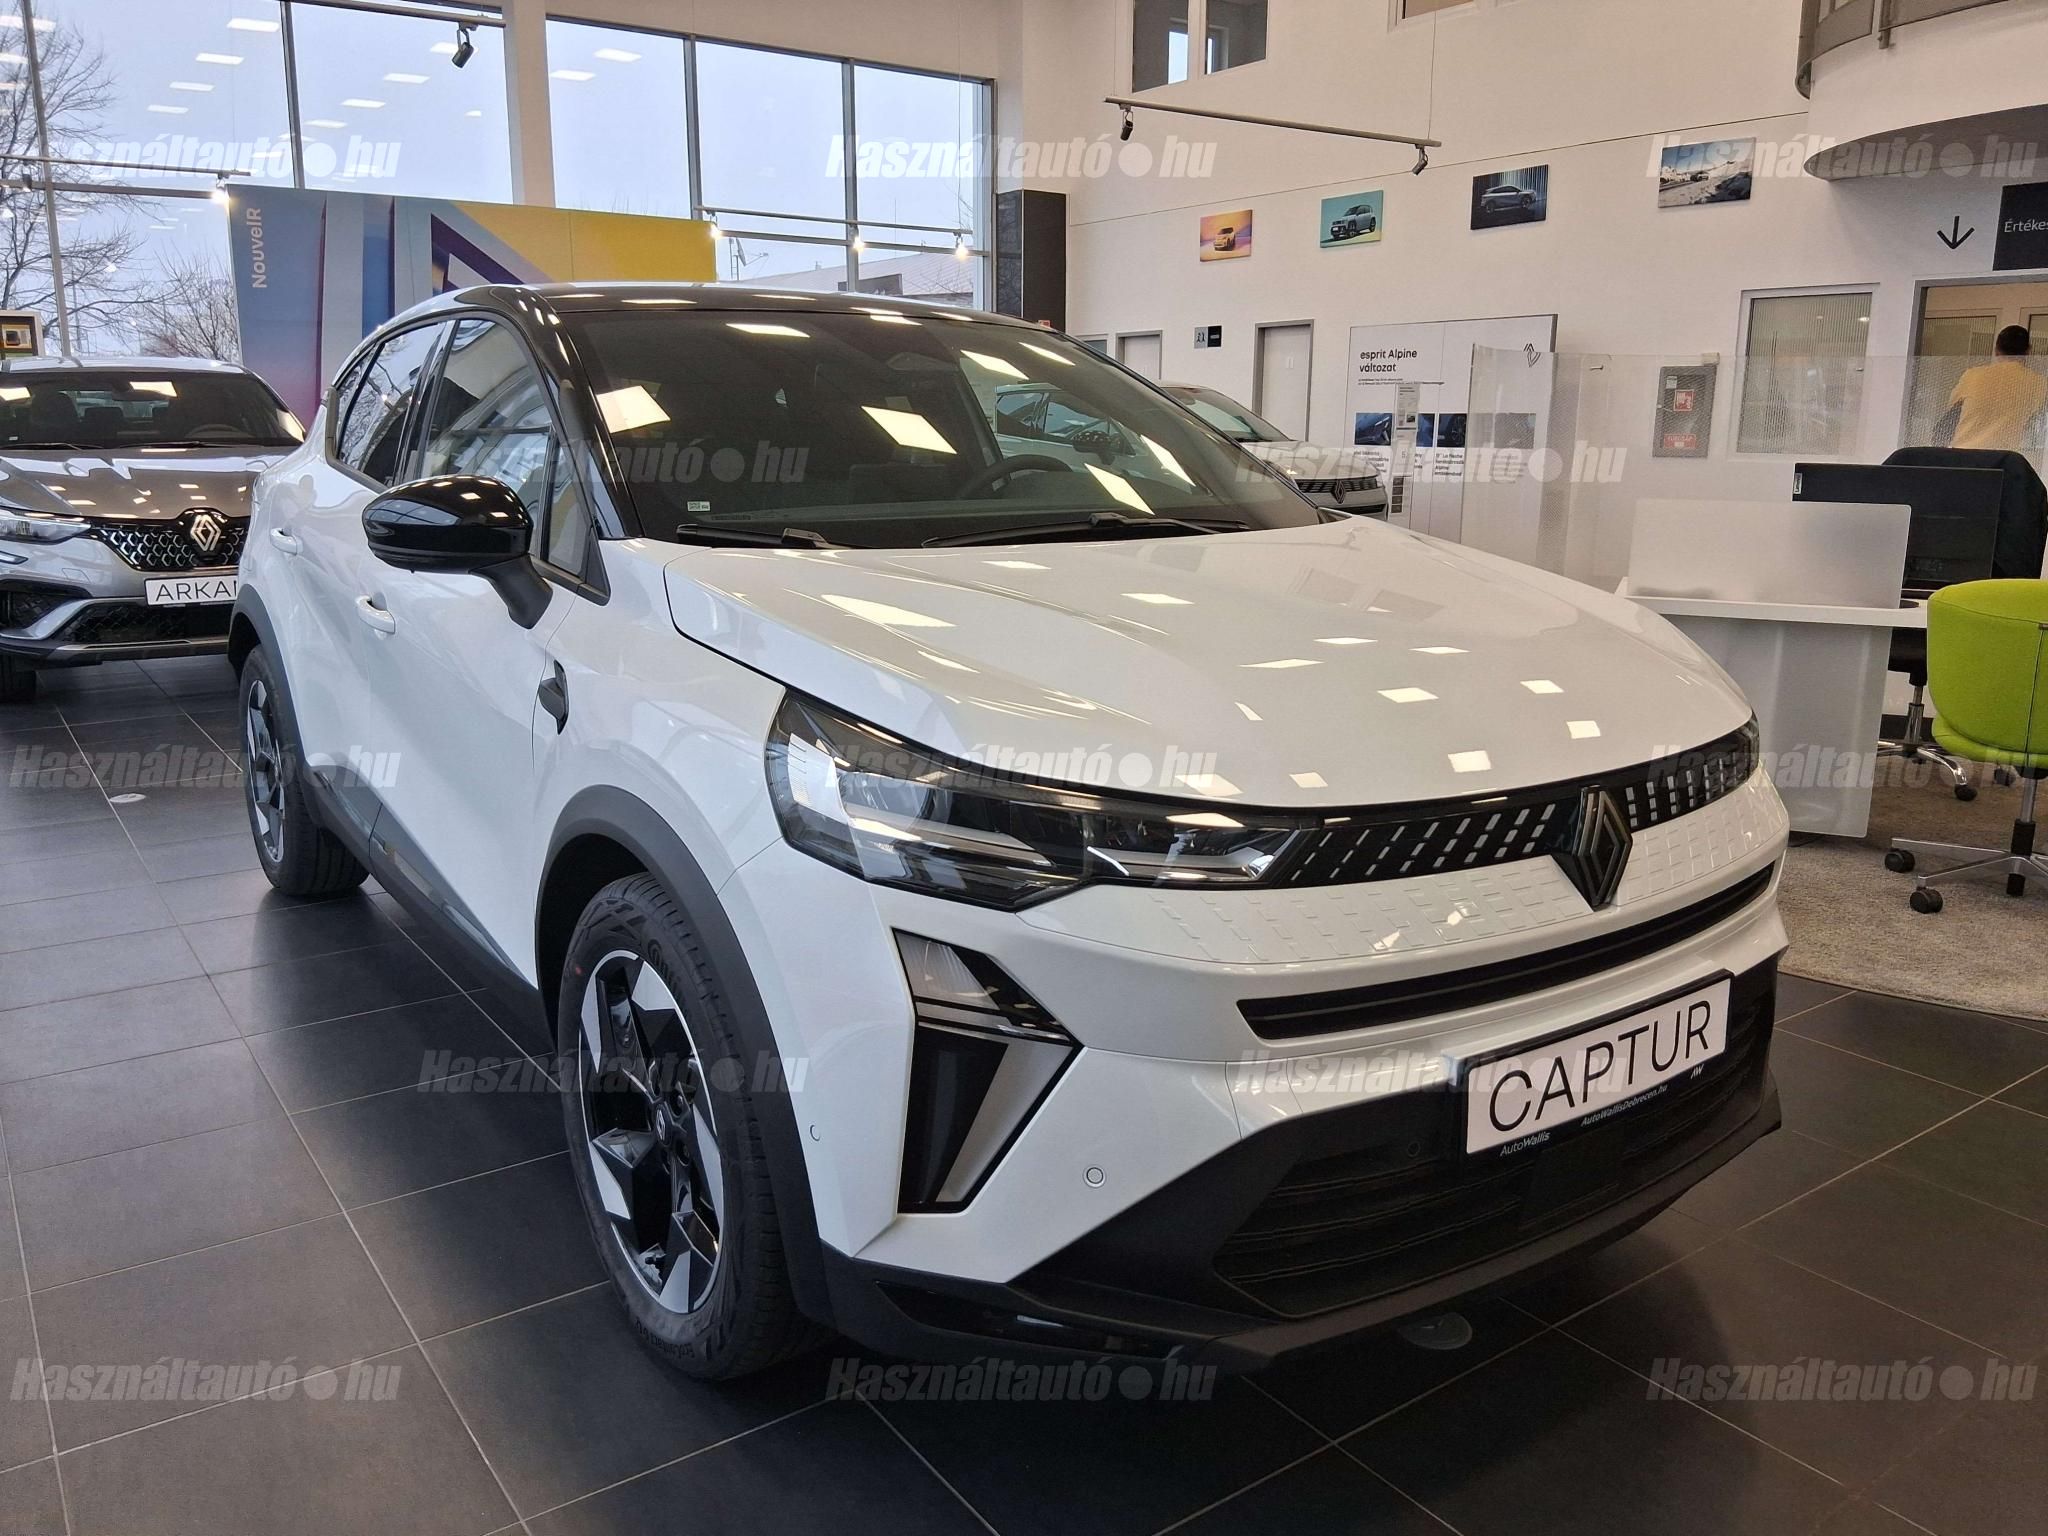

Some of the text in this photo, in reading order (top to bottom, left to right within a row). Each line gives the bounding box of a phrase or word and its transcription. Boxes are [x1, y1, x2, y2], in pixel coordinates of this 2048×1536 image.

[1360, 348, 1418, 361] esprit Alpine
[1359, 362, 1397, 373] változat
[1489, 1000, 1711, 1132] CAPTUR
[1500, 1131, 1551, 1157] AutoWallis
